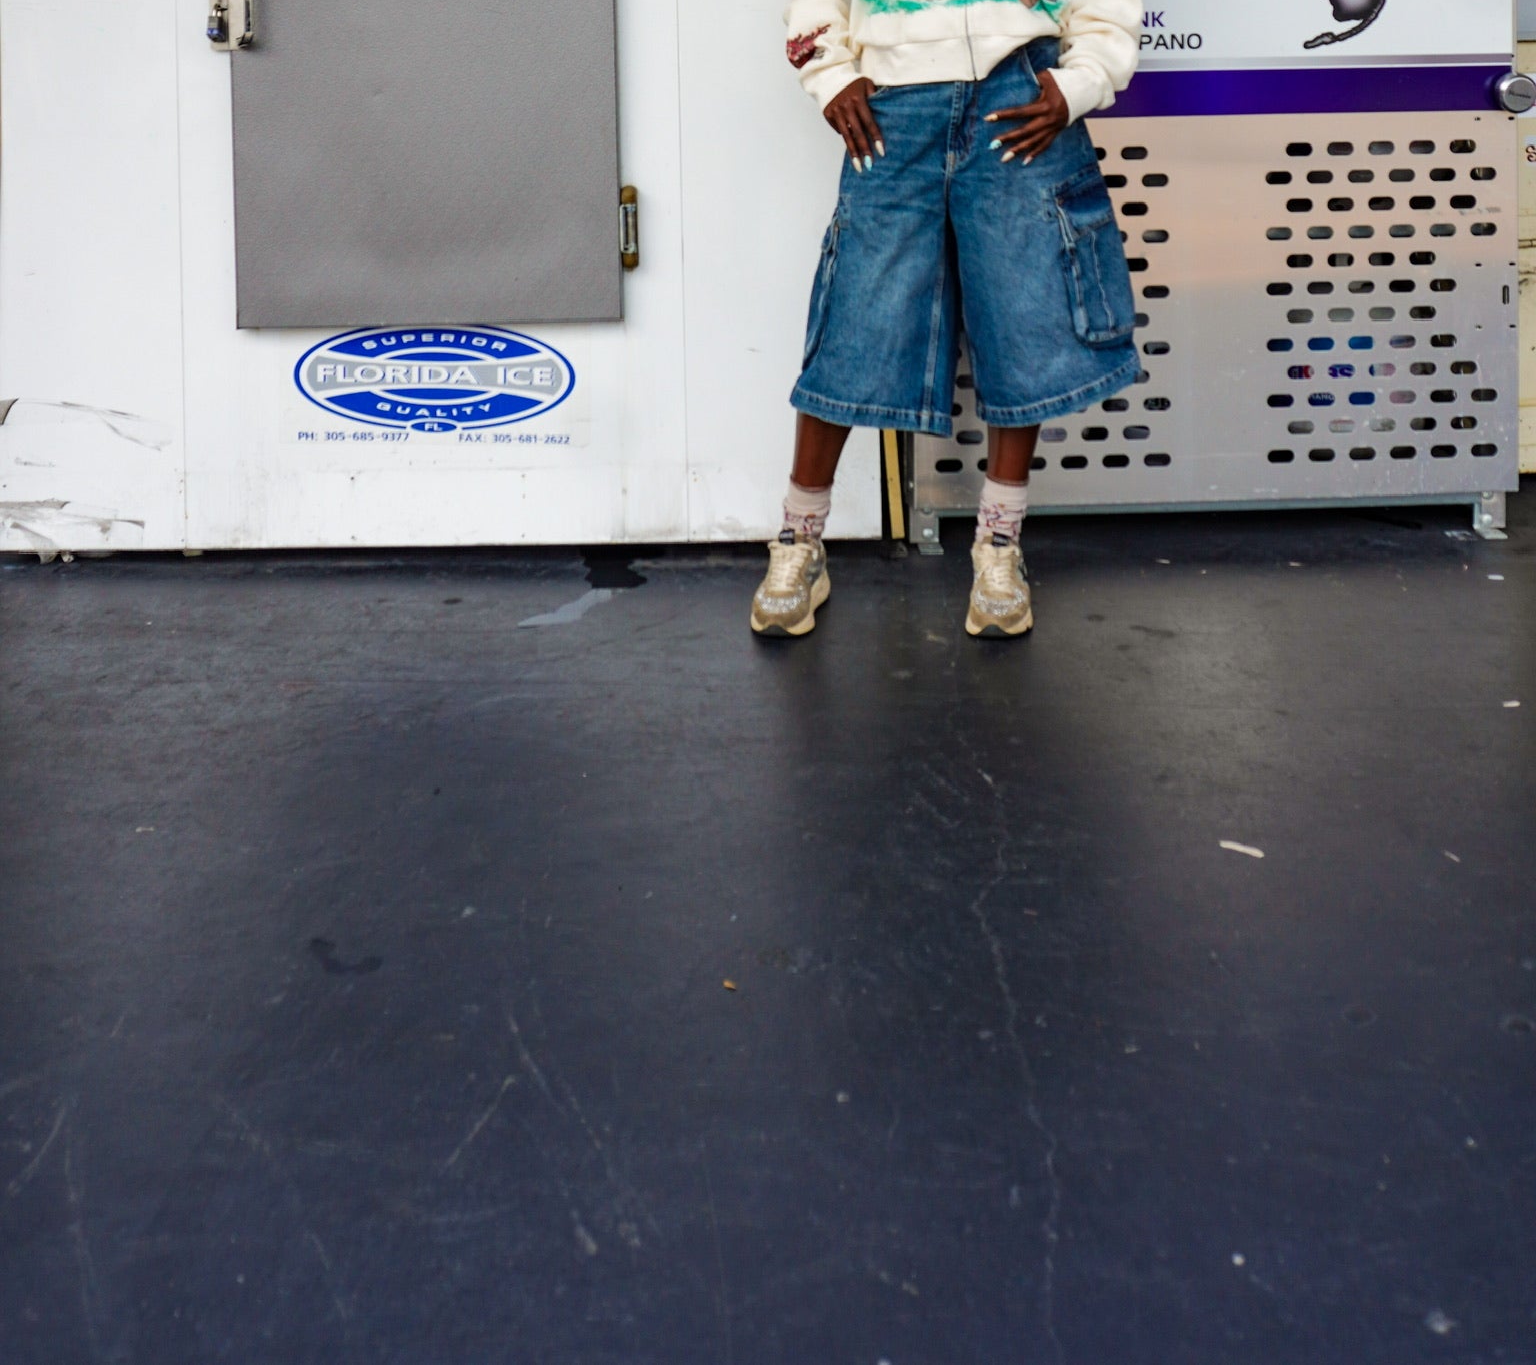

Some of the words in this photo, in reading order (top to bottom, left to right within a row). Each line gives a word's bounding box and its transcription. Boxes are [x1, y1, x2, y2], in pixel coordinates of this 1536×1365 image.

[1141, 11, 1165, 28] NK
[1138, 33, 1203, 51] PANO
[362, 332, 508, 352] SUPERIOR
[316, 364, 479, 384] FLORIDA
[497, 366, 555, 386] ICE
[376, 402, 491, 418] QUALITY
[424, 421, 443, 432] FL
[298, 431, 318, 442] PH:
[324, 431, 410, 442] 305-685-9377
[458, 433, 488, 443] FAX:
